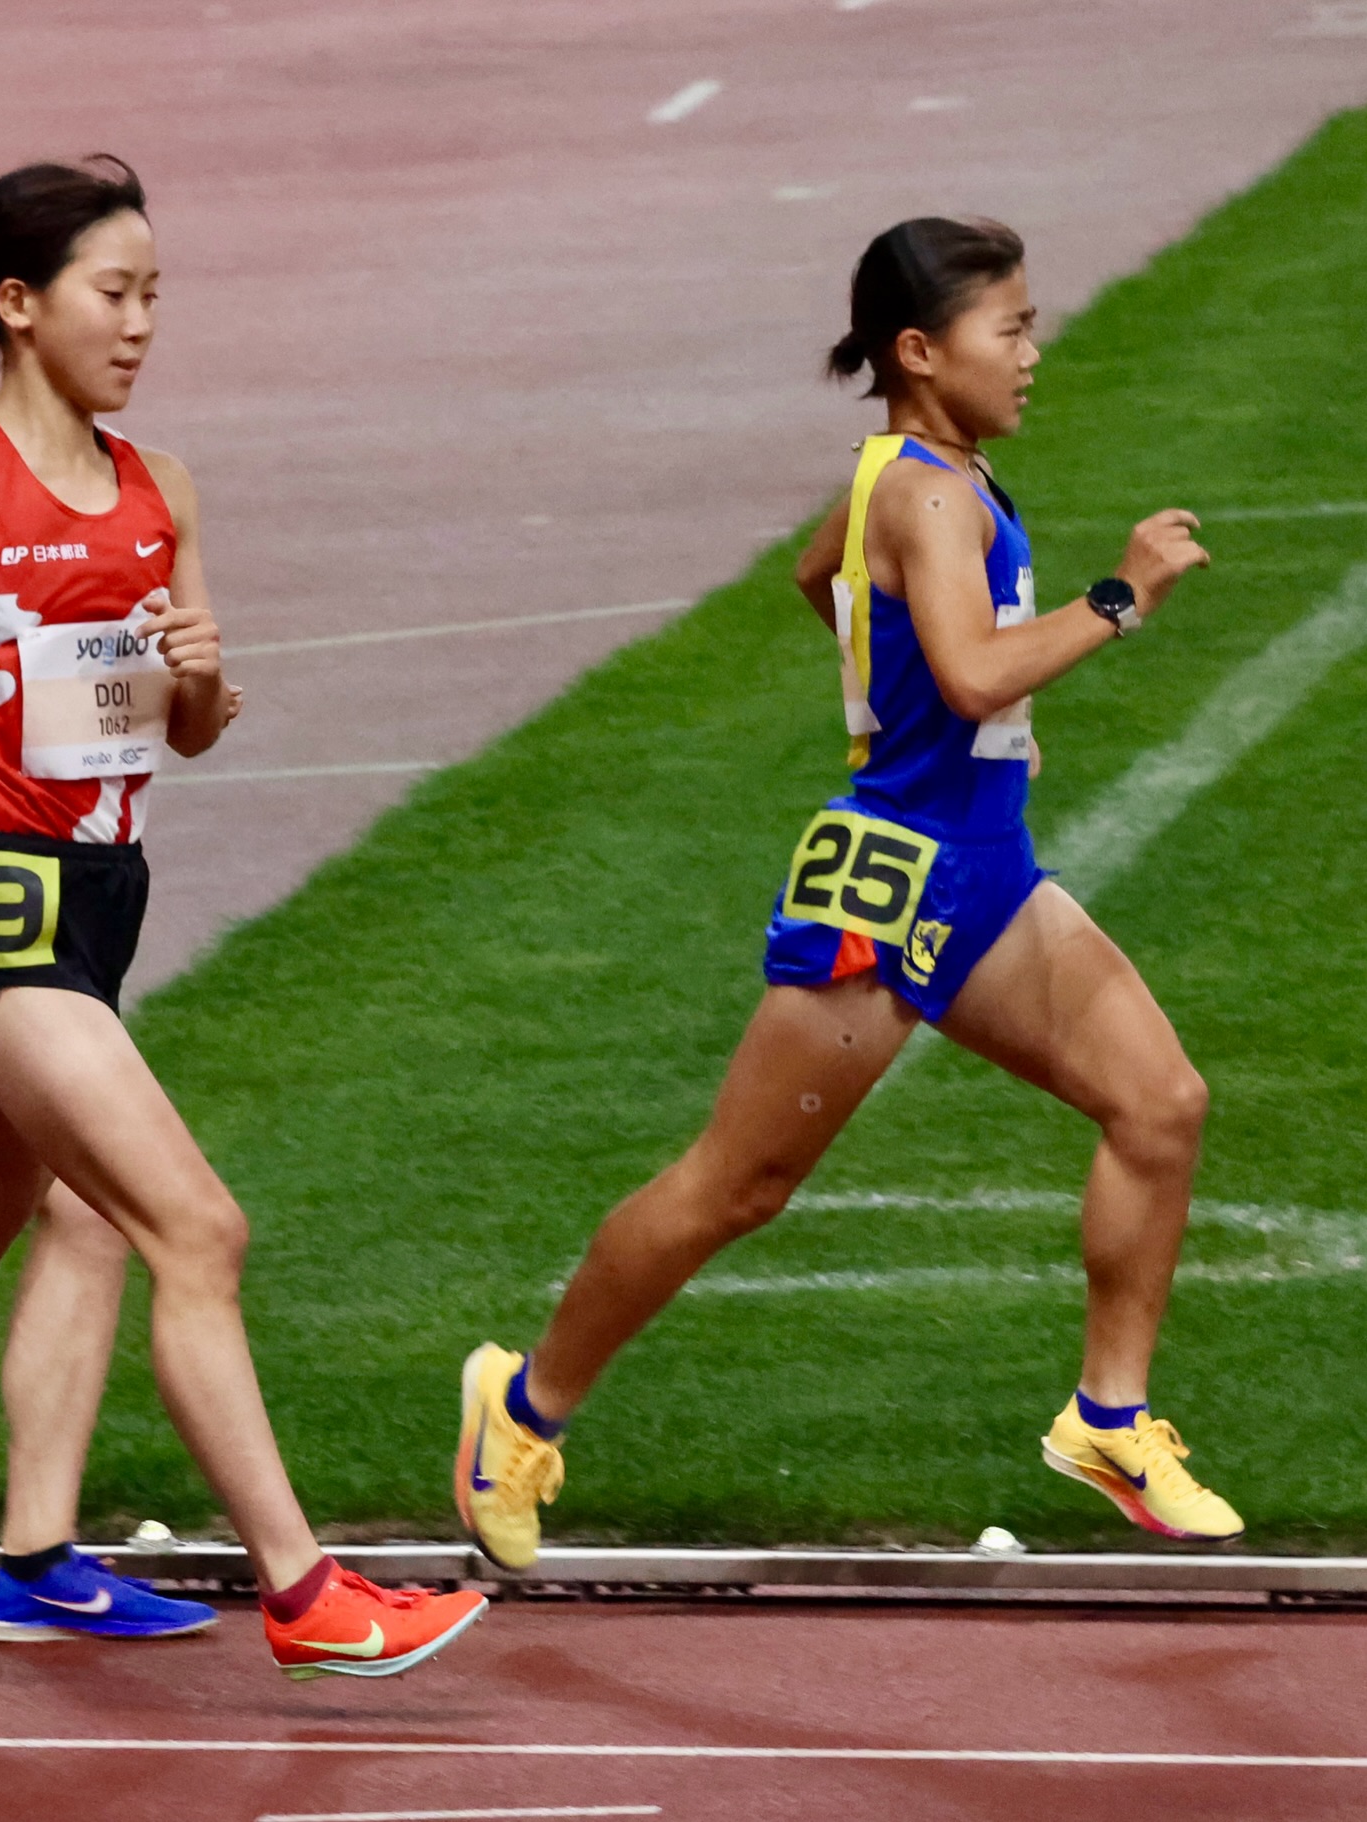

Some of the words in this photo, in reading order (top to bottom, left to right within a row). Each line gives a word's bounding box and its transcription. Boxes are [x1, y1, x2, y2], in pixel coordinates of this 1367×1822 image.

[33, 543, 89, 562] 日本郵政
[77, 629, 149, 666] yogibo
[95, 681, 131, 708] DOI
[99, 715, 130, 736] 1062
[792, 823, 922, 925] 25
